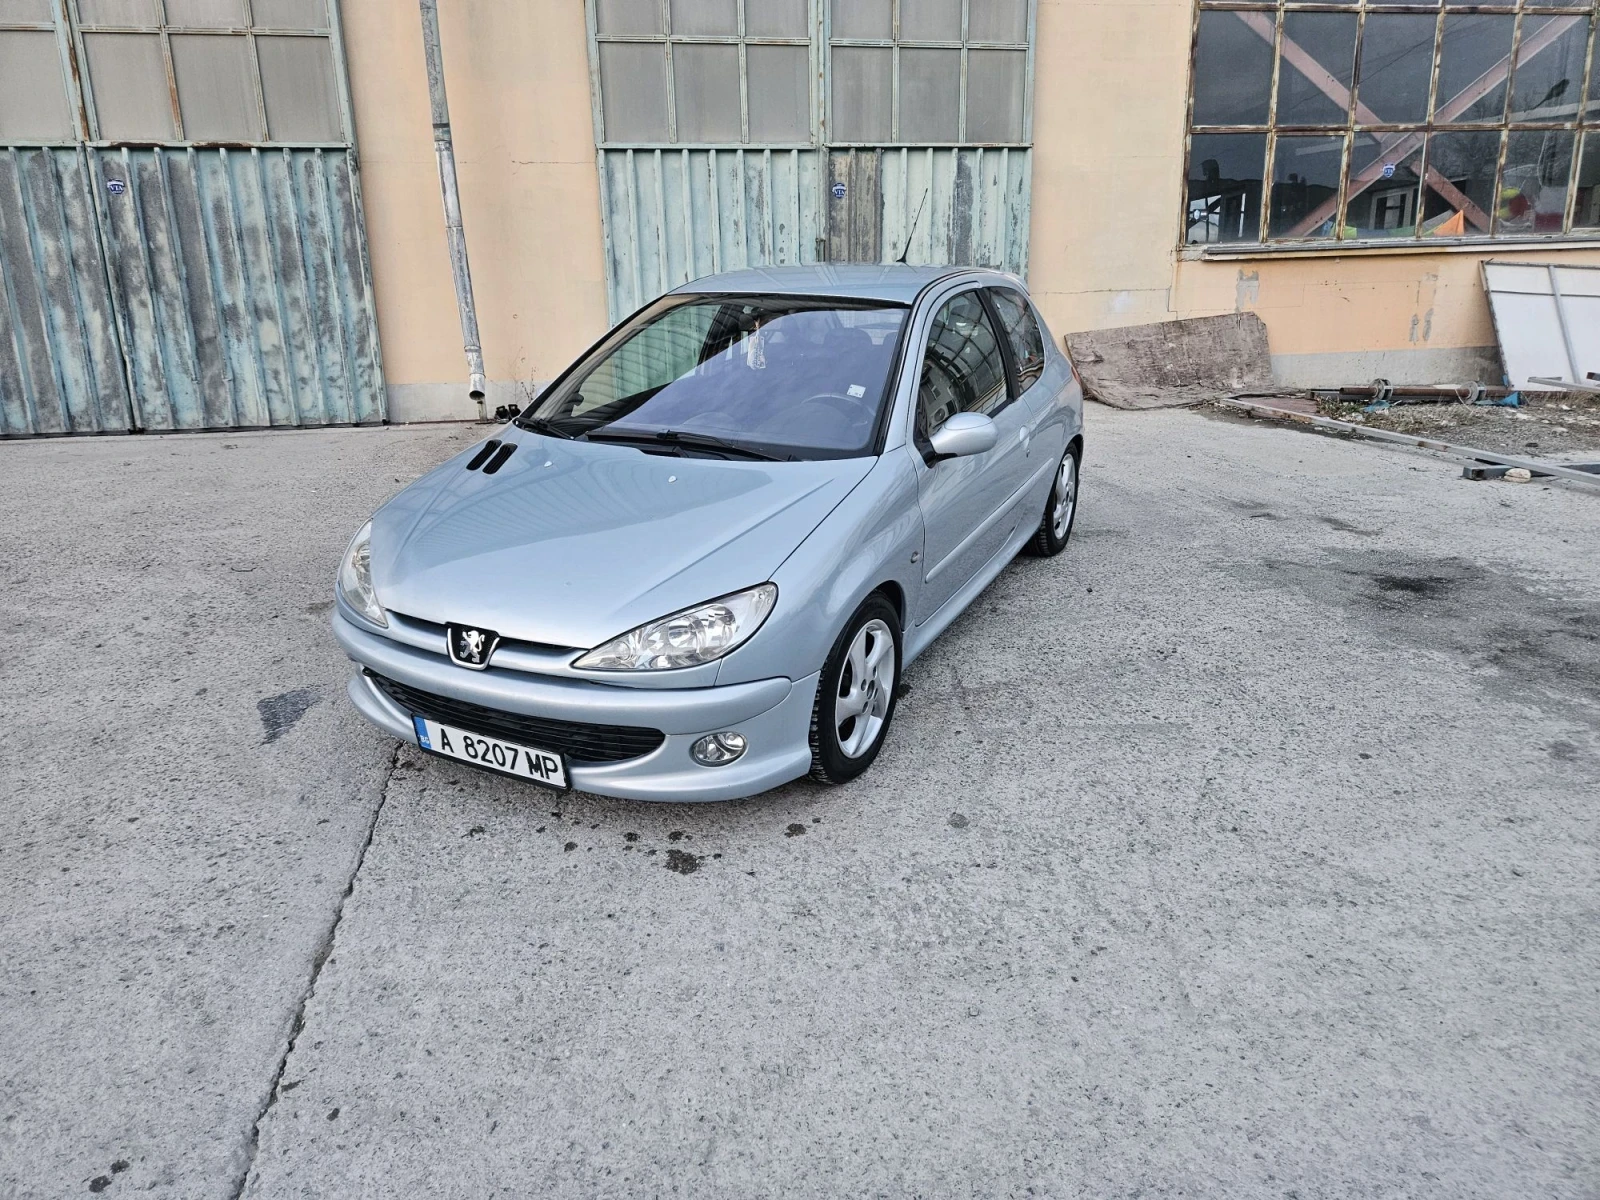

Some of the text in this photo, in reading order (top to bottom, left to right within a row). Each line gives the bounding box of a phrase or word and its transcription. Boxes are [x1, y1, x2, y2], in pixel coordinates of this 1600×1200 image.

[440, 728, 558, 780] A 8207 MP
